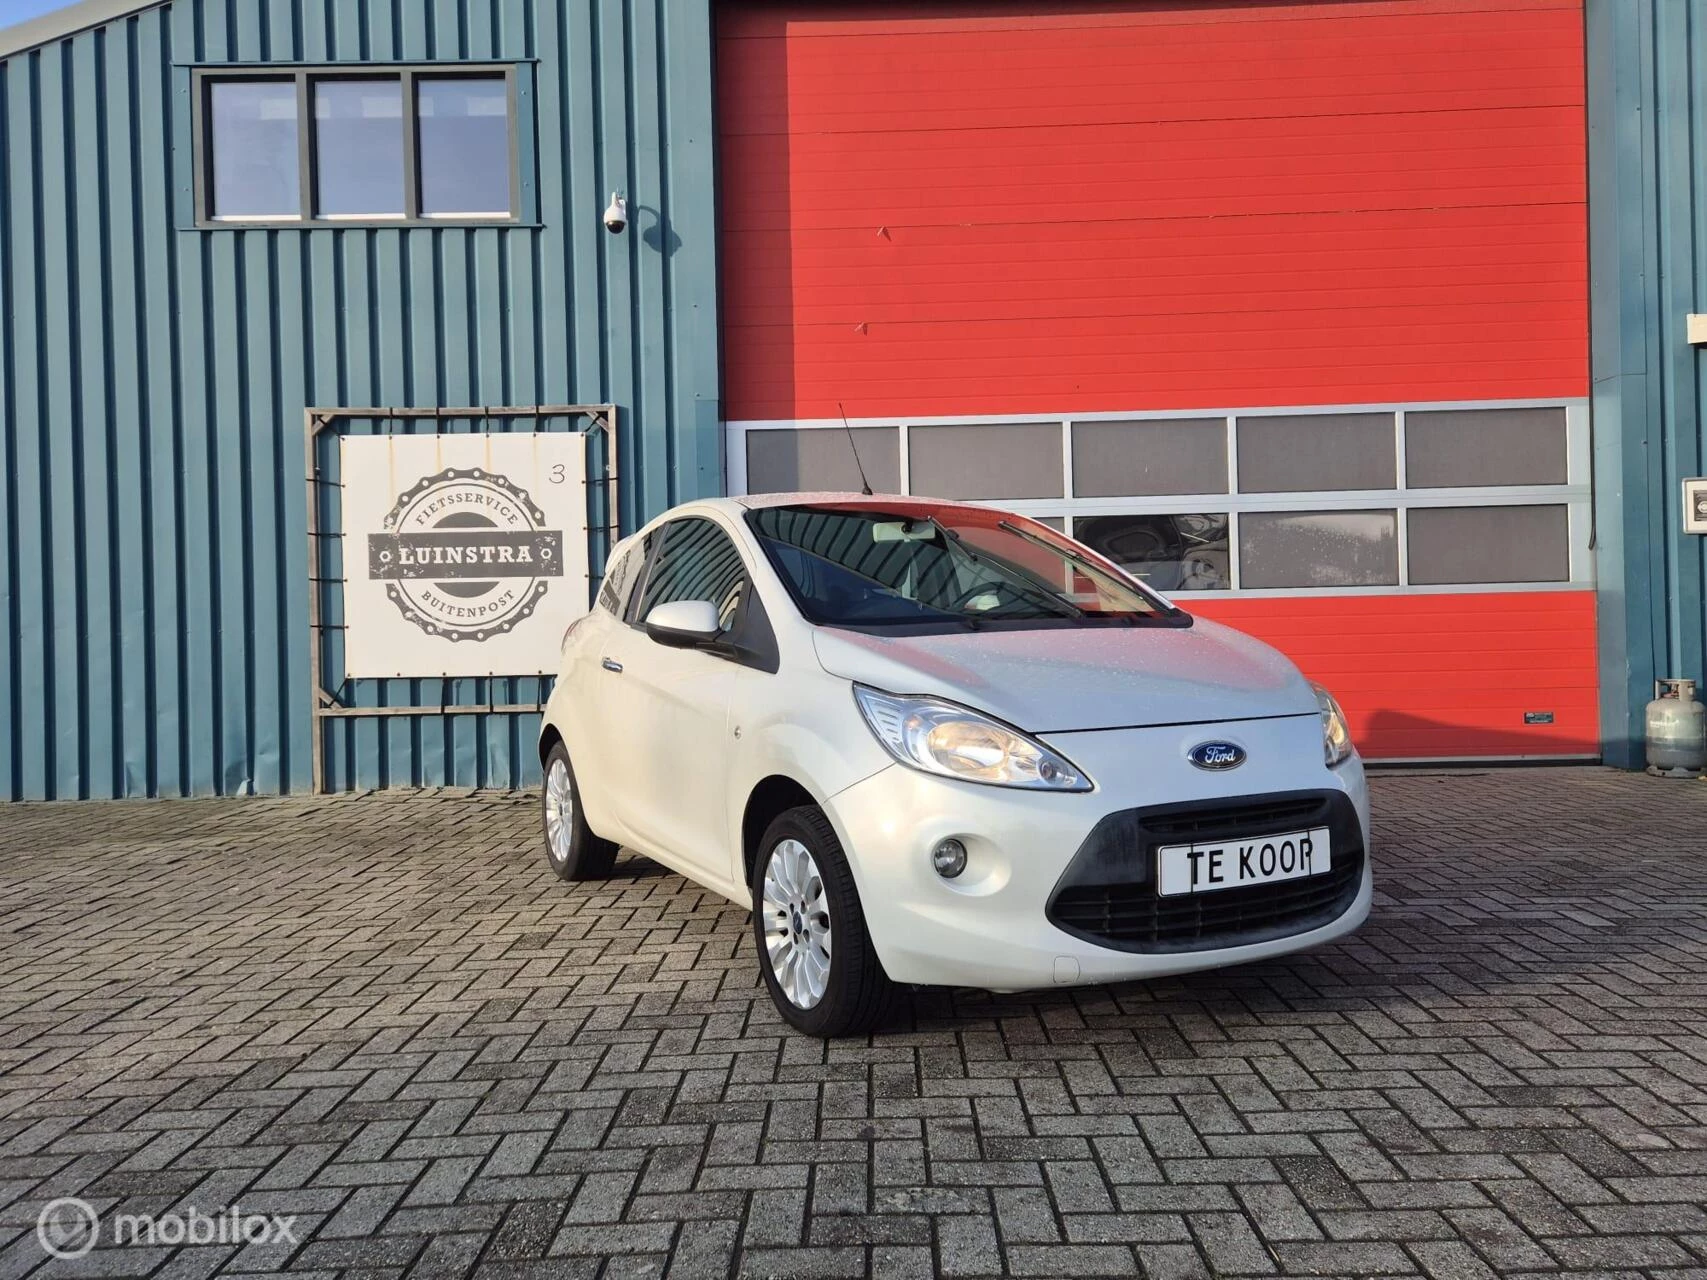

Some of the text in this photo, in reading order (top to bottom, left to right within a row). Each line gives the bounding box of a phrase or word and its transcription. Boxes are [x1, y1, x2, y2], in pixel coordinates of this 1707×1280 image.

[549, 464, 566, 484] 3
[416, 492, 518, 525] FIETSSERVICE
[398, 546, 533, 565] LUINSTRA
[421, 590, 514, 617] BUITENPOST
[1204, 746, 1236, 763] Ford
[1186, 839, 1313, 885] TE KOOP
